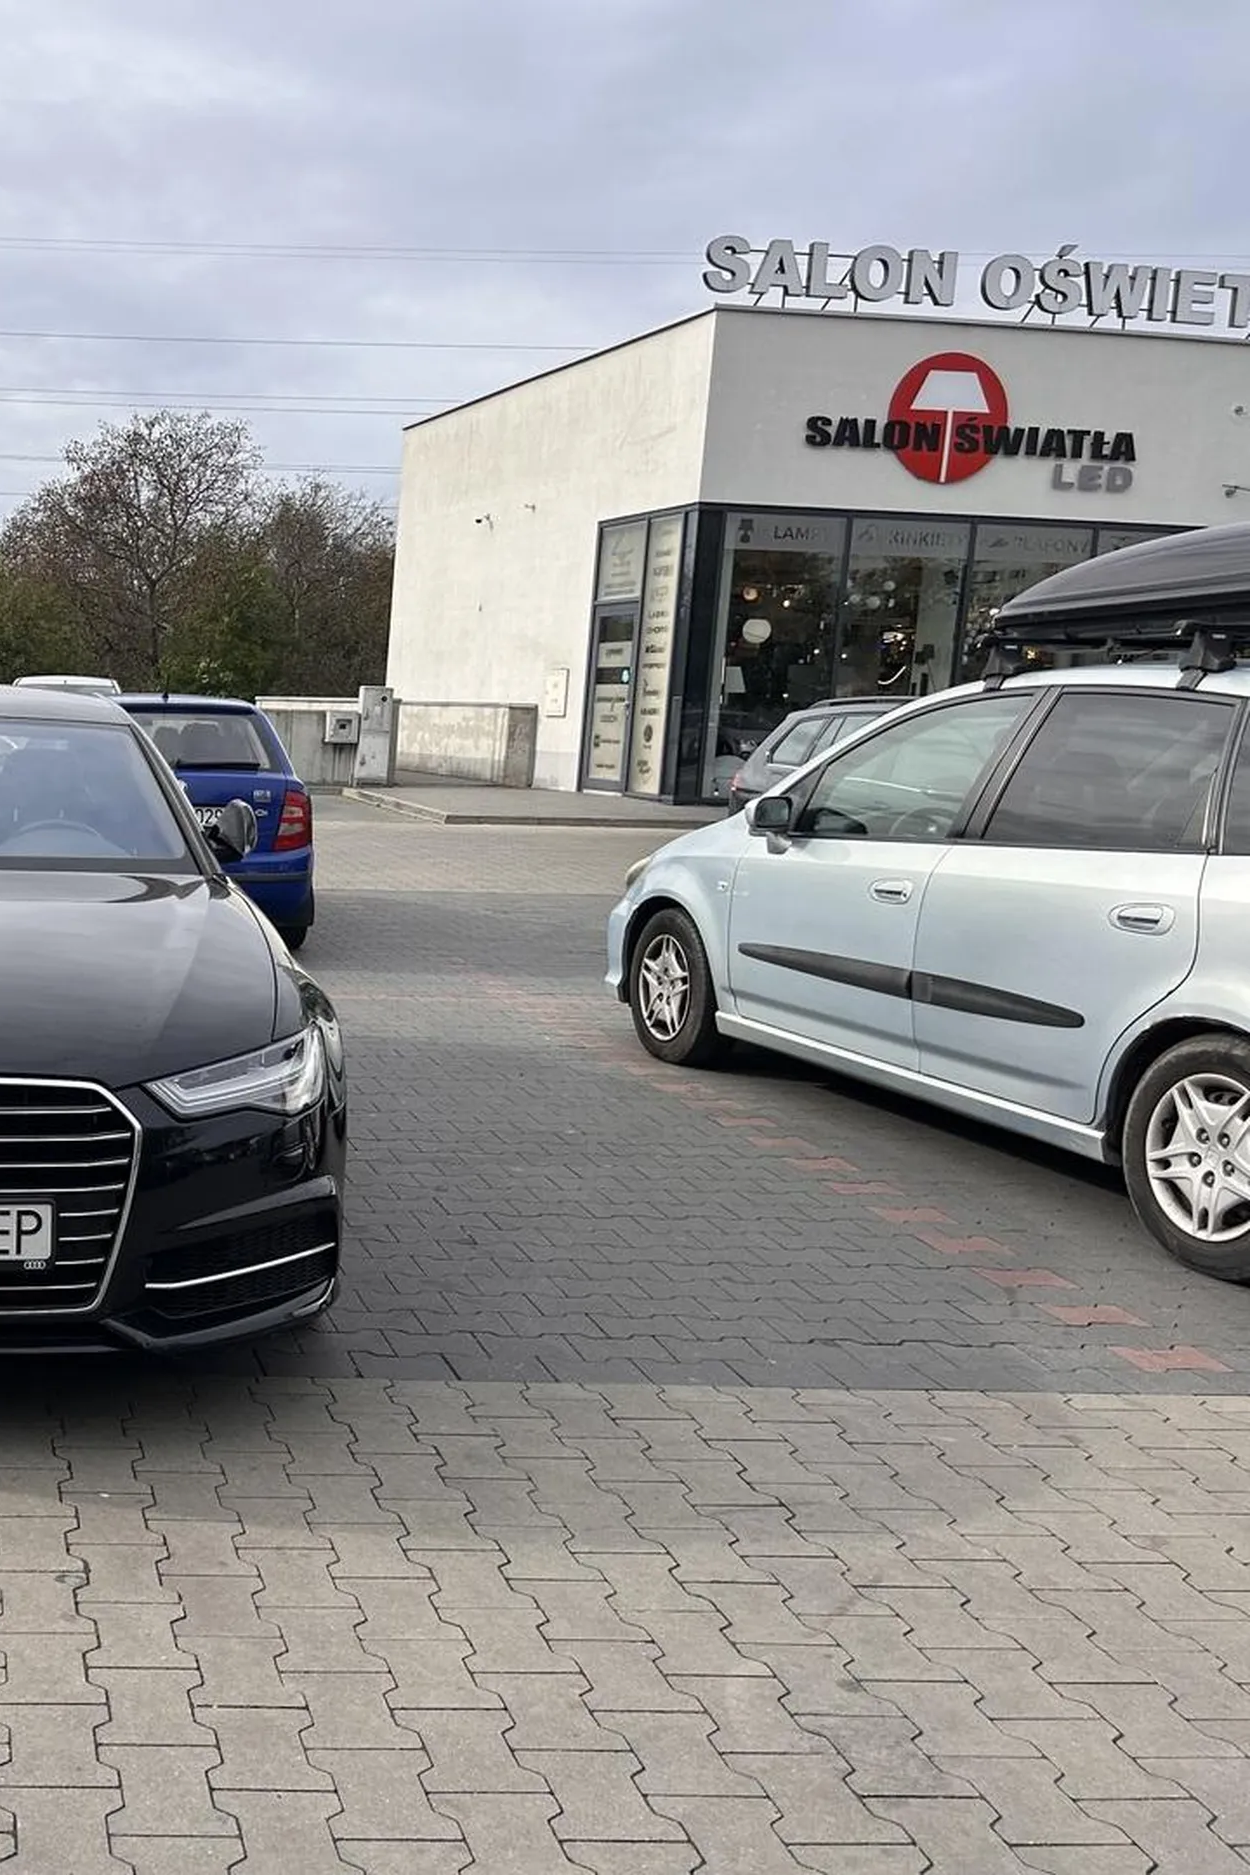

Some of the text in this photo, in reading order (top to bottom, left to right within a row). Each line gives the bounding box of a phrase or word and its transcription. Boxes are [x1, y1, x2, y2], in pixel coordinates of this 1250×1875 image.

[702, 235, 1250, 328] SALON OŚWIET
[805, 416, 1137, 461] SALON ŚWIATŁA
[1052, 463, 1134, 493] LED
[773, 525, 828, 542] LAMP
[888, 526, 967, 548] KINKIE
